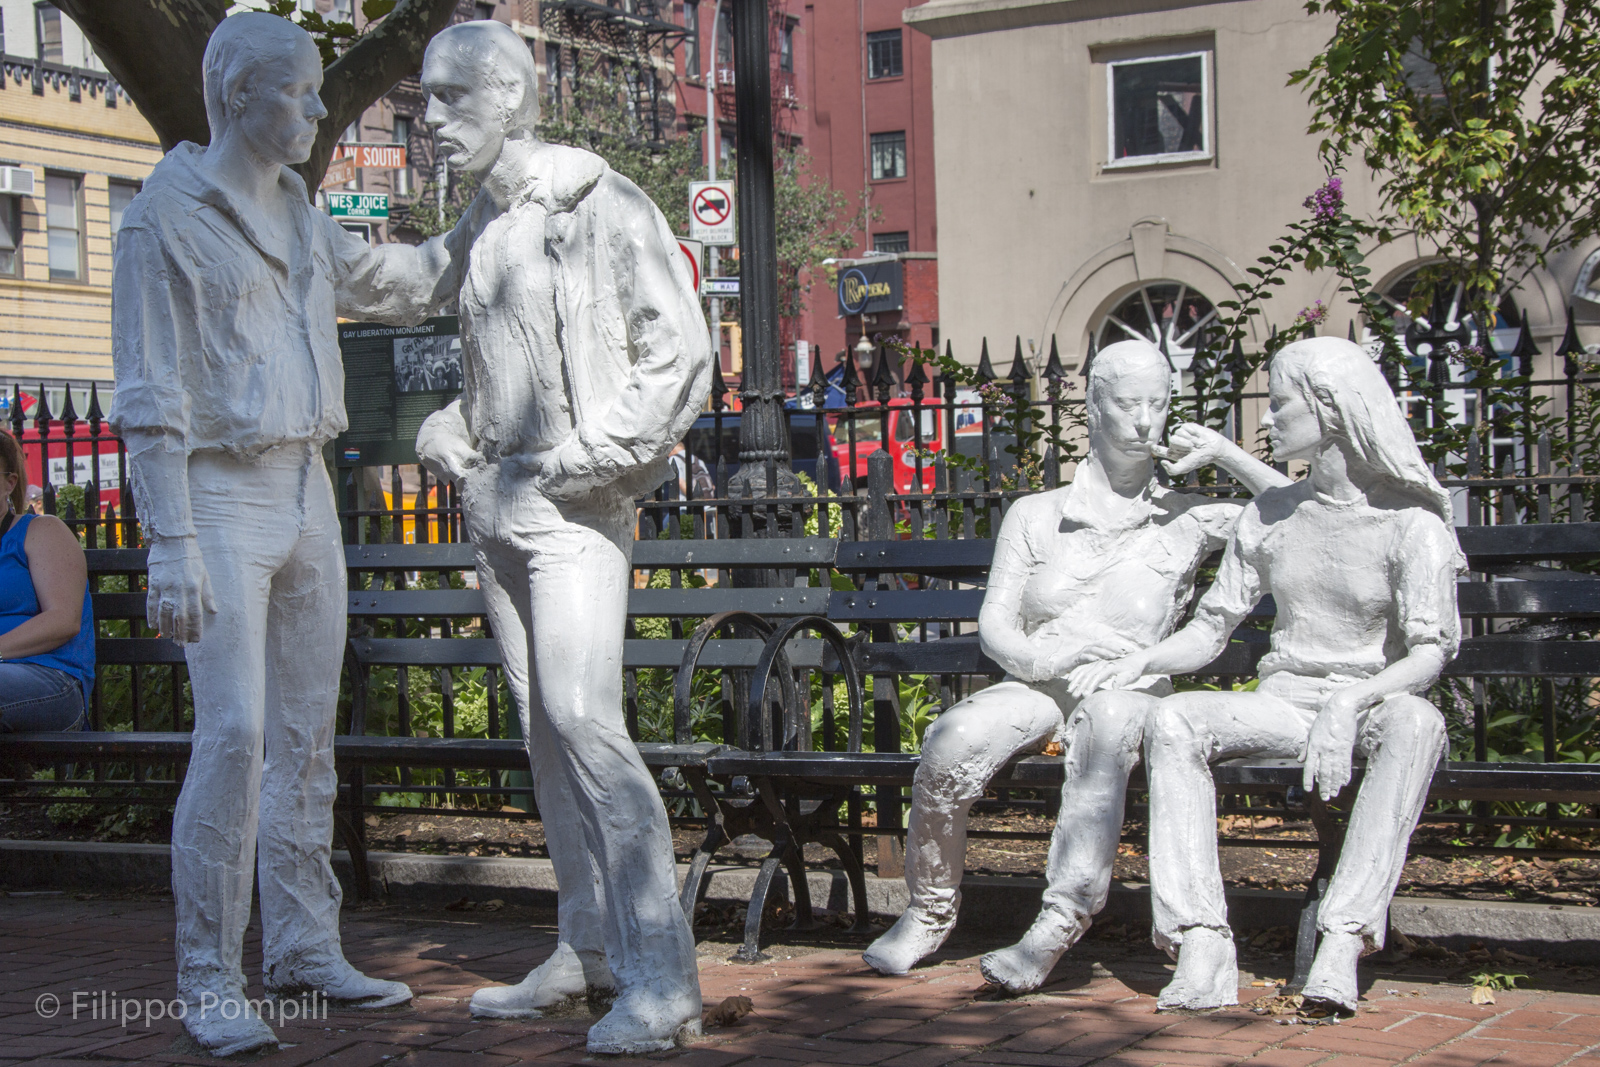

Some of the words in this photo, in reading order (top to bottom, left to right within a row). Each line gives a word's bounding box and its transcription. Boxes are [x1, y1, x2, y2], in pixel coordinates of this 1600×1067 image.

[363, 147, 400, 167] SOUTH
[330, 195, 353, 208] WES
[356, 196, 386, 210] JOICE
[347, 208, 370, 216] CORNER
[701, 282, 716, 290] ONE
[720, 282, 735, 290] WAY
[343, 331, 356, 339] GAY
[357, 328, 395, 338] LIBERATION
[395, 325, 435, 335] MONUMENT
